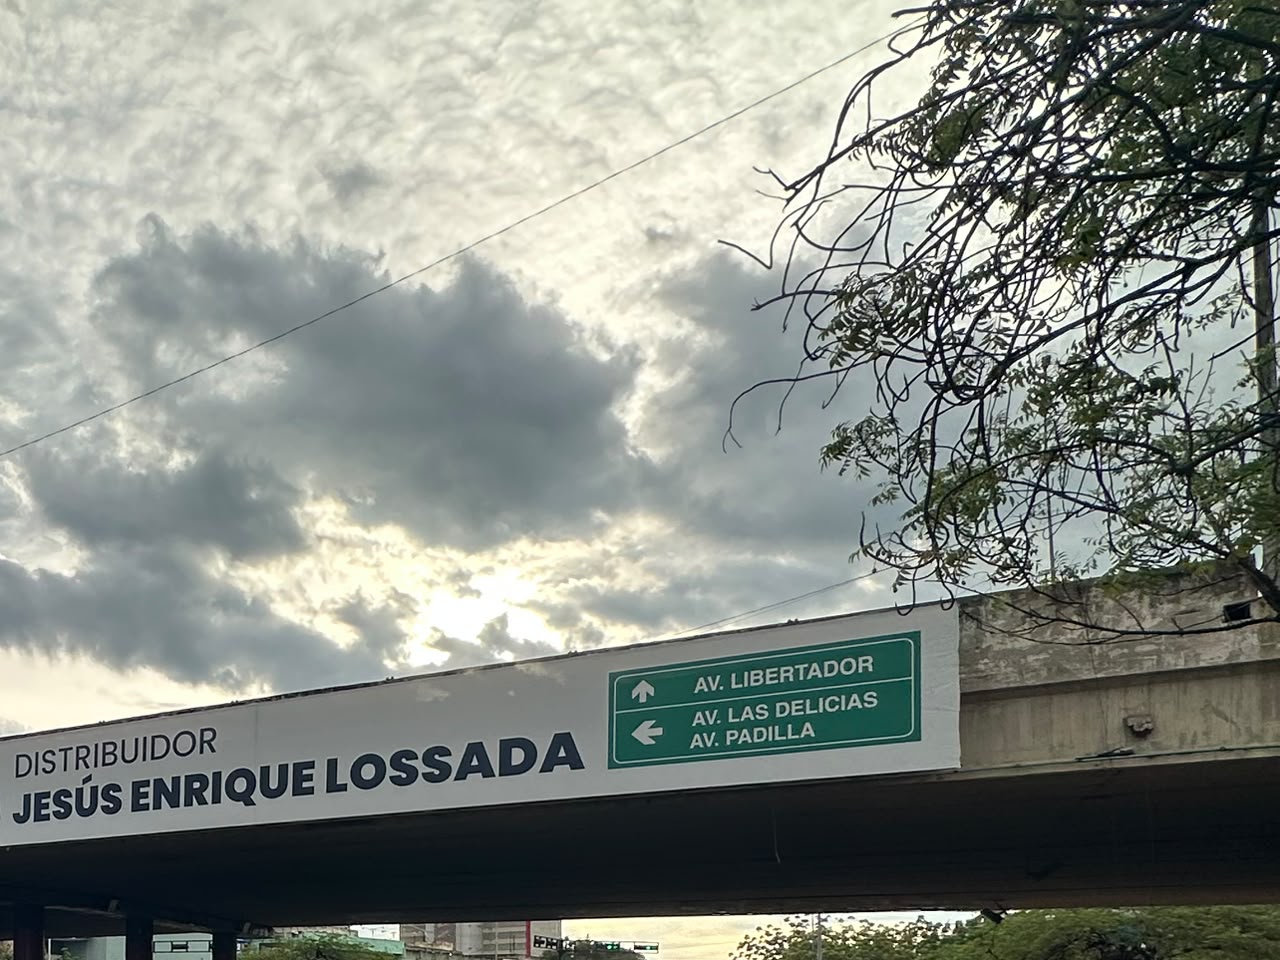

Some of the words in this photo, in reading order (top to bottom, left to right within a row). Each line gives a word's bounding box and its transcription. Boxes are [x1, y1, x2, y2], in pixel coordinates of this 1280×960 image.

[693, 675, 724, 694] AV.
[730, 655, 874, 690] LIBERTADOR
[691, 709, 721, 727] AV.
[728, 704, 769, 723] LAS
[775, 691, 879, 718] DELICIAS
[15, 727, 218, 779] DISTRIBUIDOR
[689, 732, 719, 750] AV.
[726, 722, 816, 746] PADILLA
[12, 774, 123, 825] JESÚS
[130, 760, 316, 813] ENRIQUE
[325, 731, 586, 794] LOSSADA
